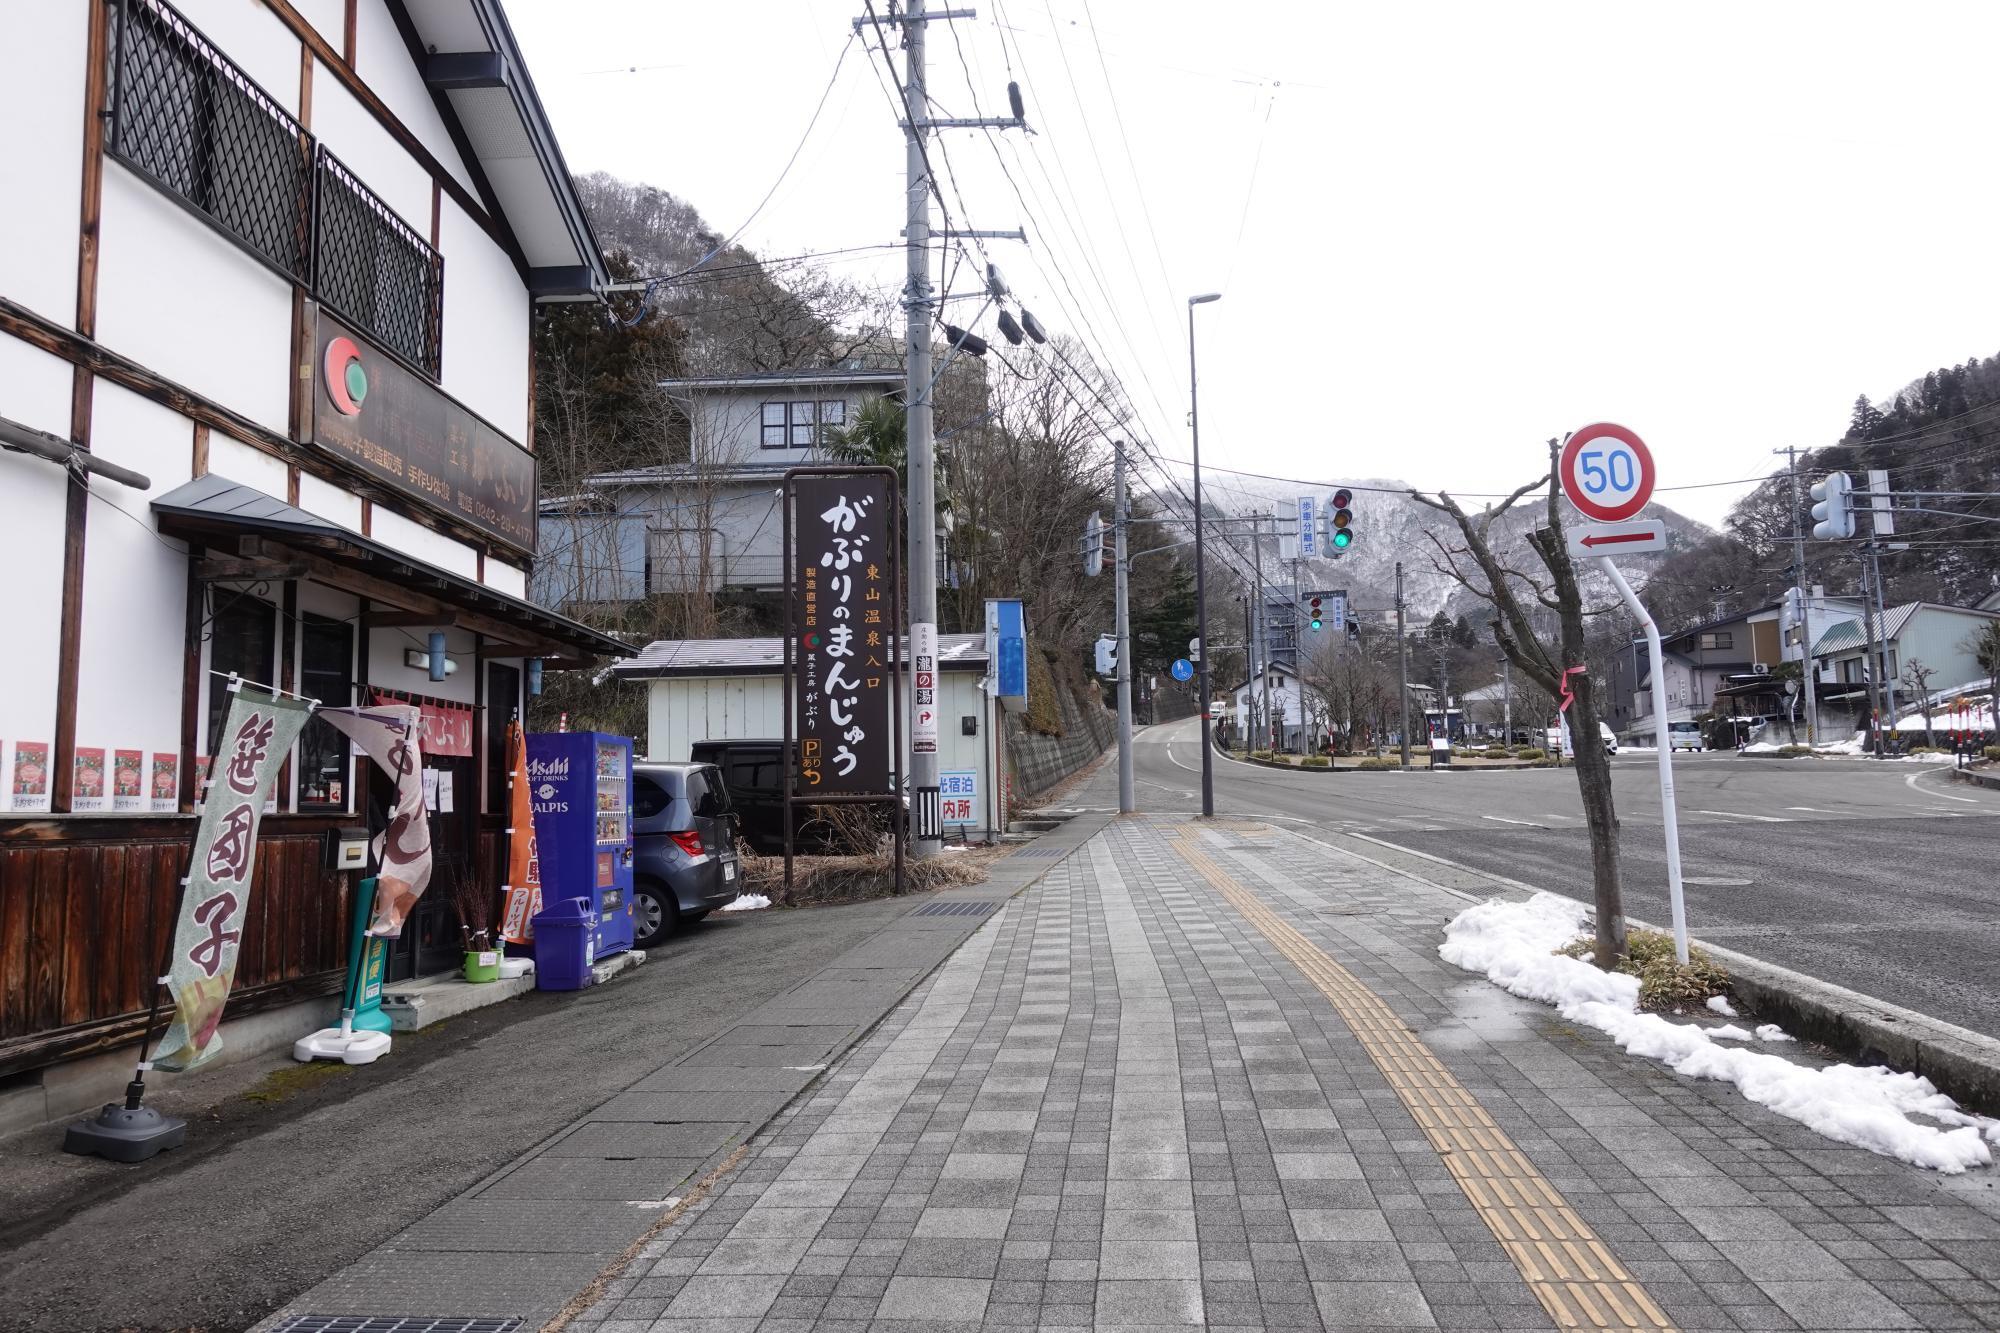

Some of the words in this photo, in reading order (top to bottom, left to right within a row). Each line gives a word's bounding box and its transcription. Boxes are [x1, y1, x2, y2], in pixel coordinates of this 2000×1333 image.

[1581, 450, 1634, 493] 50
[1302, 501, 1313, 553] 歩車分離式
[806, 567, 817, 626] 製造直営店
[820, 495, 873, 777] がぶりのまんじゅう
[864, 563, 882, 689] 東山温泉入口
[917, 656, 932, 704] 瀧の湯
[527, 757, 569, 776] Asahi
[802, 758, 821, 768] あり
[806, 741, 818, 756] P
[531, 801, 569, 813] ALPIS
[943, 800, 971, 819] 内所
[187, 711, 276, 980] 笹団子
[507, 890, 527, 937] フルーツパイ
